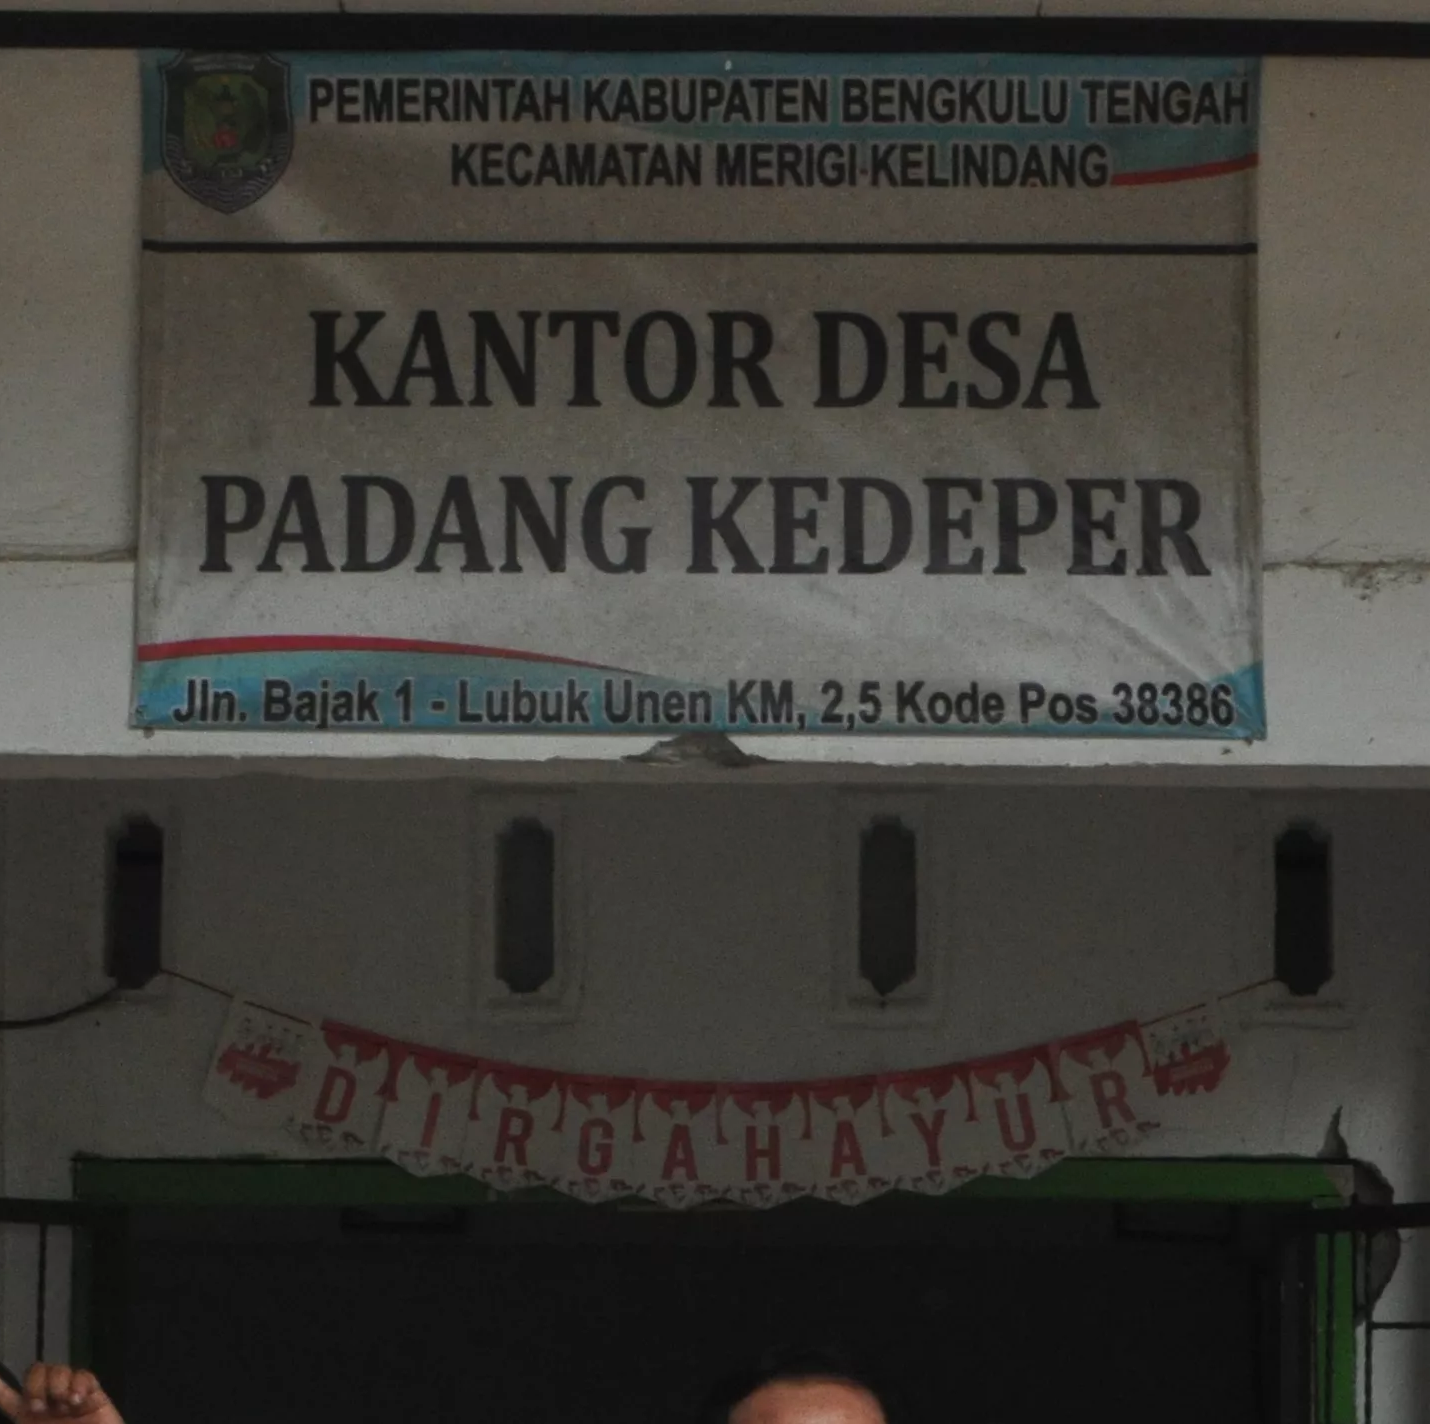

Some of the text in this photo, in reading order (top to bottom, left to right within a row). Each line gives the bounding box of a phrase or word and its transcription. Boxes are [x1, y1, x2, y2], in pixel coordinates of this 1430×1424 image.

[308, 77, 1248, 125] PEMERINTAH KABUPATEN BENGKULU TENGAH
[451, 142, 1109, 188] KECAMATAN MERIGI KELINDANG
[308, 309, 1101, 410] KANTOR DESA
[199, 474, 1212, 577] PADANG KEDEPER
[174, 678, 246, 723] Jln.
[263, 679, 380, 729] Bajak
[394, 679, 413, 722] 1
[459, 679, 590, 724] Lubuk
[604, 680, 711, 724] Unen
[728, 679, 807, 730] KM,
[820, 680, 881, 731] 2,5
[896, 680, 1004, 724] Kode
[1019, 682, 1099, 724] Pos
[1112, 682, 1235, 728] 38386
